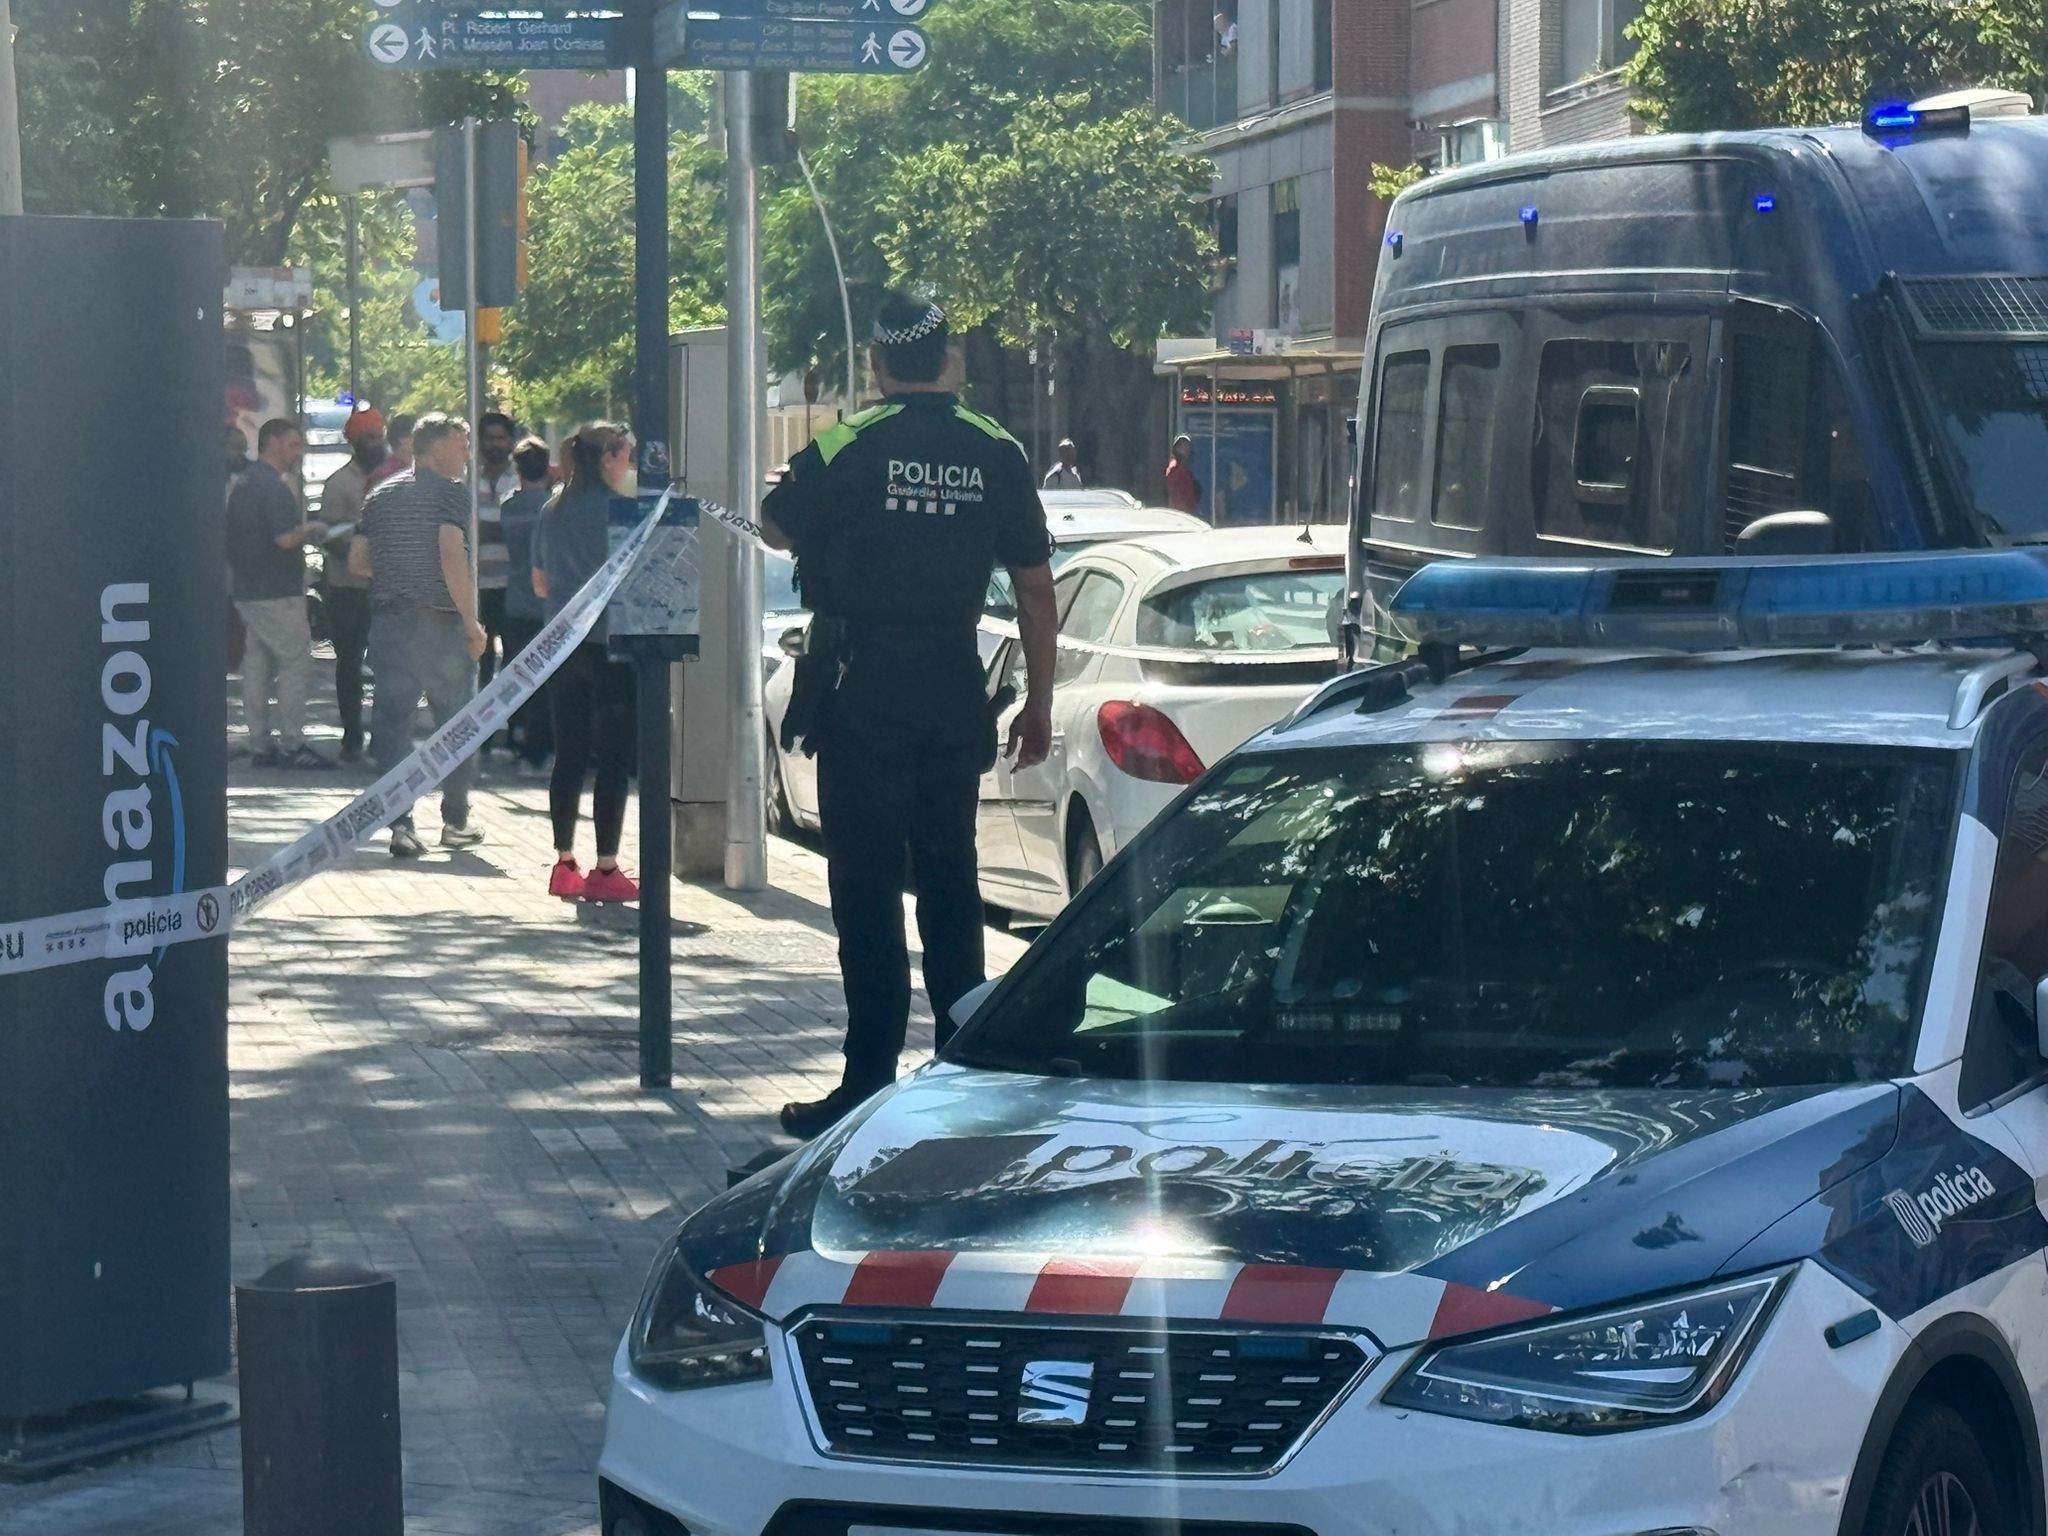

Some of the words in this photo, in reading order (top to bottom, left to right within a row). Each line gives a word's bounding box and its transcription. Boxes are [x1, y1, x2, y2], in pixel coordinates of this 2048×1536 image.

[888, 459, 984, 490] POLICIA
[124, 908, 182, 945] policia
[1917, 1164, 1997, 1234] policia
